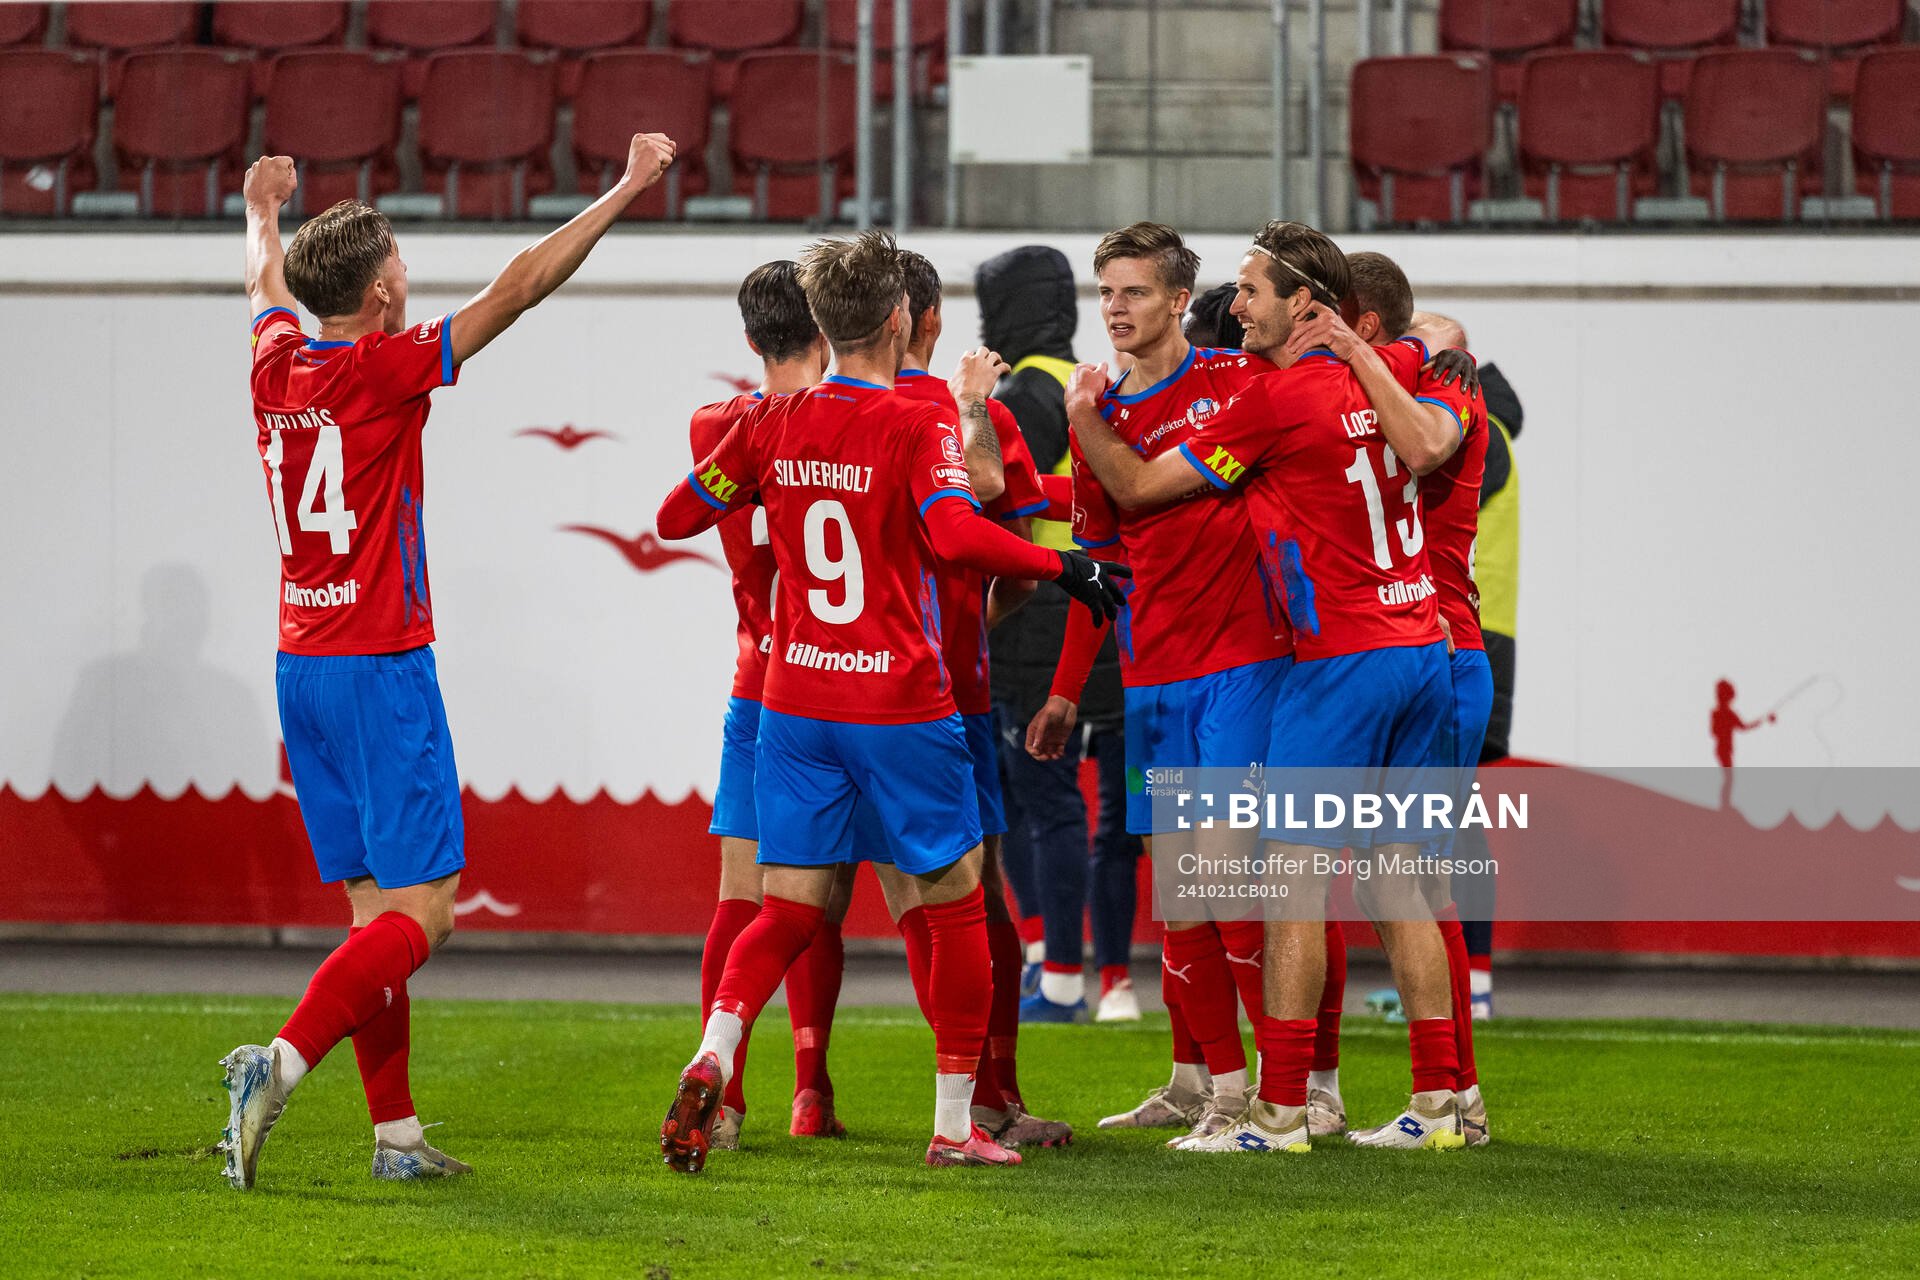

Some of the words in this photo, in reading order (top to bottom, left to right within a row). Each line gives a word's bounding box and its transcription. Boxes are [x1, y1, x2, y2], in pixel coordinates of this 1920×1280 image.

[263, 425, 358, 555] 14
[699, 461, 739, 503] XXL
[774, 459, 873, 493] SILVERHOLT
[1344, 442, 1424, 570] 13
[803, 499, 865, 625] 9
[285, 579, 357, 607] tillmobil
[785, 641, 890, 673] tillmobil
[1145, 769, 1184, 785] Solid
[1249, 761, 1264, 778] 21
